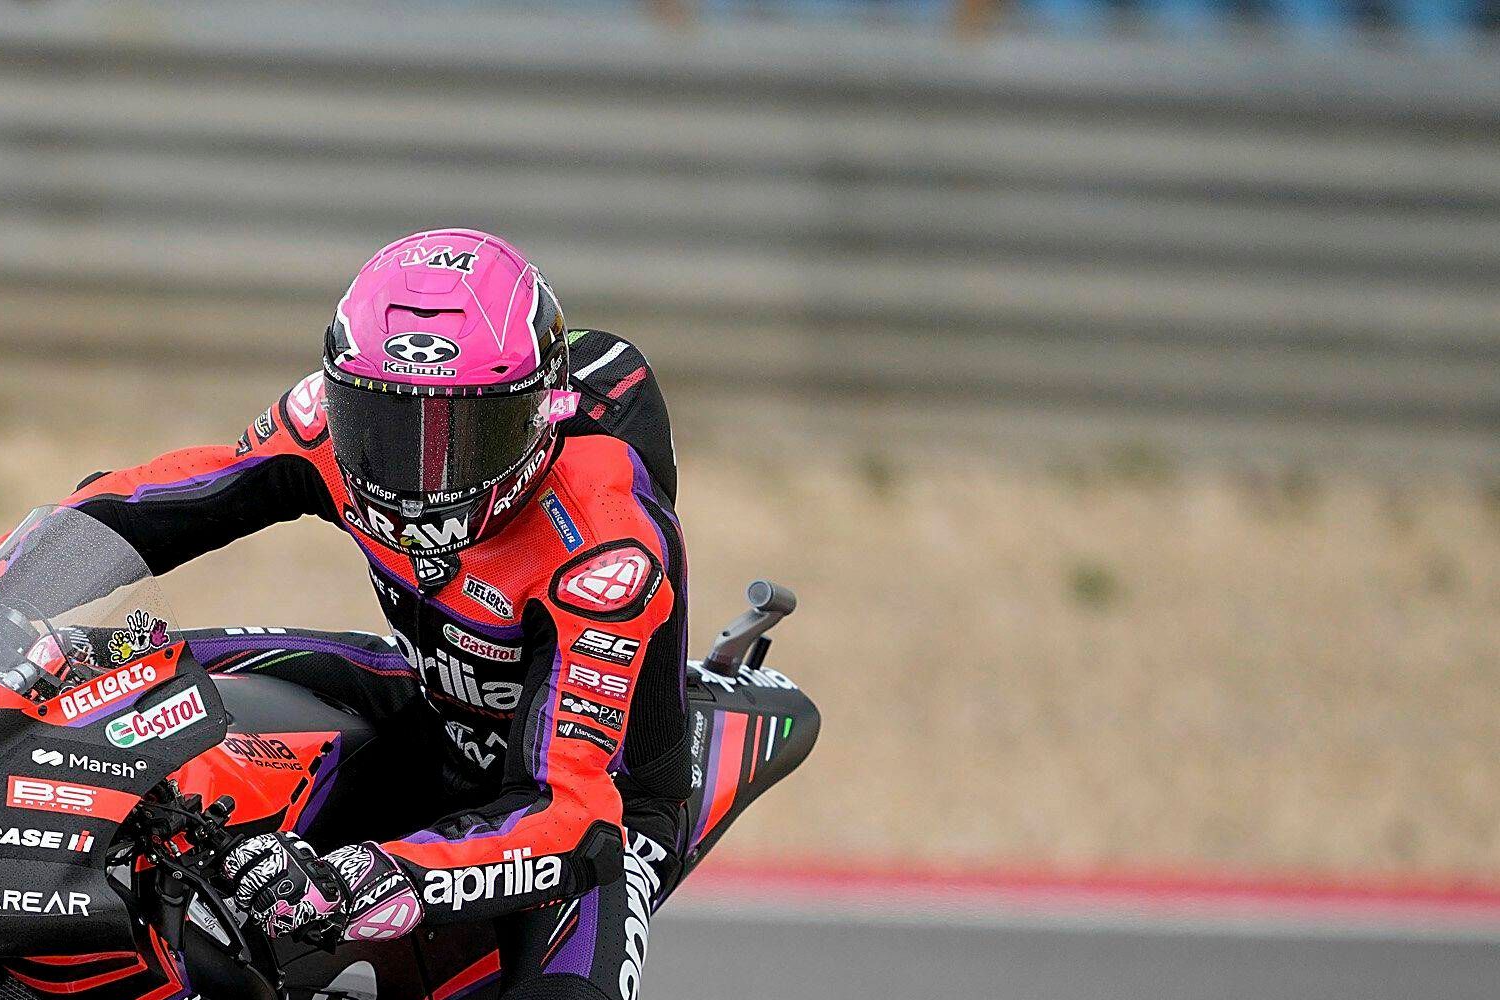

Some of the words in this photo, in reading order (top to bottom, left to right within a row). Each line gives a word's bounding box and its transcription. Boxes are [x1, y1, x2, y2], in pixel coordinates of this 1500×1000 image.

[383, 360, 456, 376] Kabuto
[510, 369, 546, 393] Kabuto
[354, 377, 388, 393] MAX
[550, 395, 576, 416] 41
[366, 481, 397, 500] Wispr
[493, 449, 546, 516] aprilia
[427, 490, 463, 504] Wispr
[367, 505, 469, 549] RAW
[551, 507, 576, 545] MICHELIN
[412, 537, 471, 557] HYDRATION
[459, 634, 517, 662] Castrol
[576, 629, 641, 658] SC
[567, 665, 631, 694] BS
[132, 692, 204, 738] Castrol
[224, 733, 297, 762] aprilia
[69, 754, 135, 779] Marsh
[255, 759, 303, 770] RACING
[13, 780, 97, 807] BS
[13, 798, 93, 813] BATTERY
[423, 847, 562, 911] aprilia
